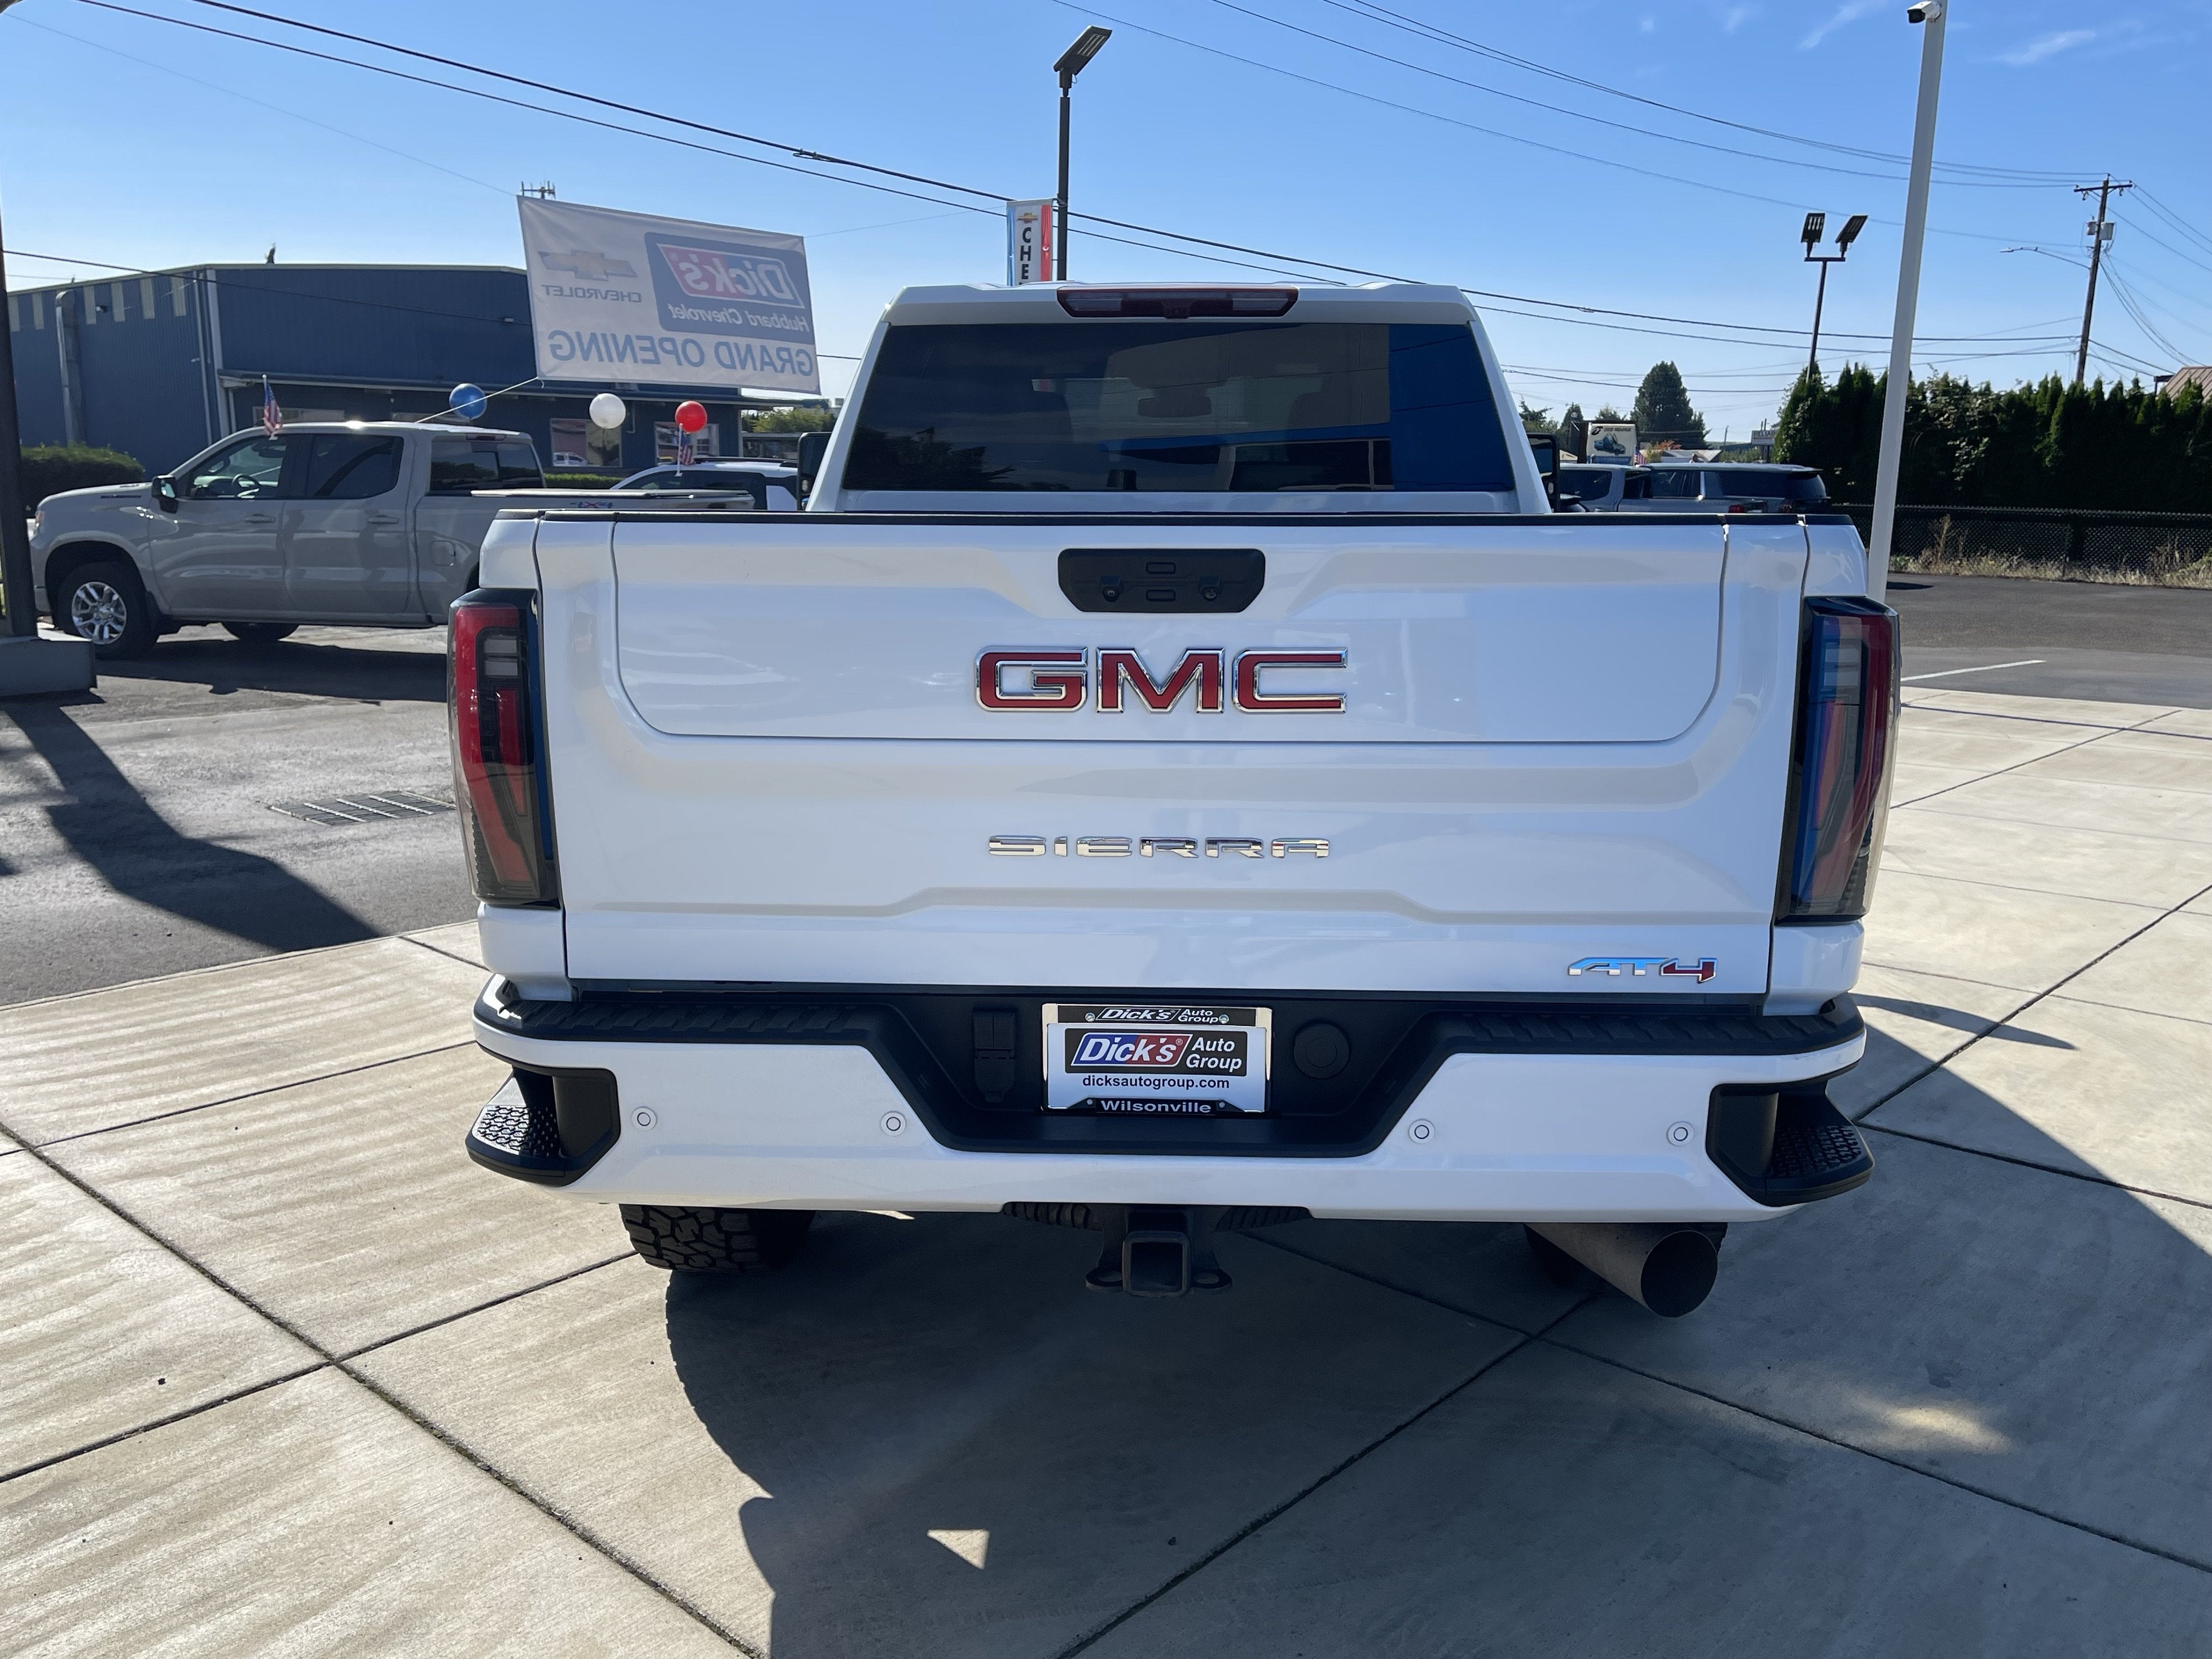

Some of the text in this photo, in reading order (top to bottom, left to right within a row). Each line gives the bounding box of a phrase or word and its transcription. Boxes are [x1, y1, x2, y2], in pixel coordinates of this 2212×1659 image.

[1019, 227, 1032, 285] CHE
[975, 646, 1348, 714] GMC
[989, 835, 1330, 859] SIERRA
[1568, 957, 1717, 984] AT4
[1178, 1015, 1219, 1024] Group
[1192, 1037, 1235, 1052] Auto
[1186, 1053, 1243, 1073] Group
[1082, 1075, 1229, 1090] dicksautogroup.com
[1101, 1100, 1211, 1113] Wilsonville
